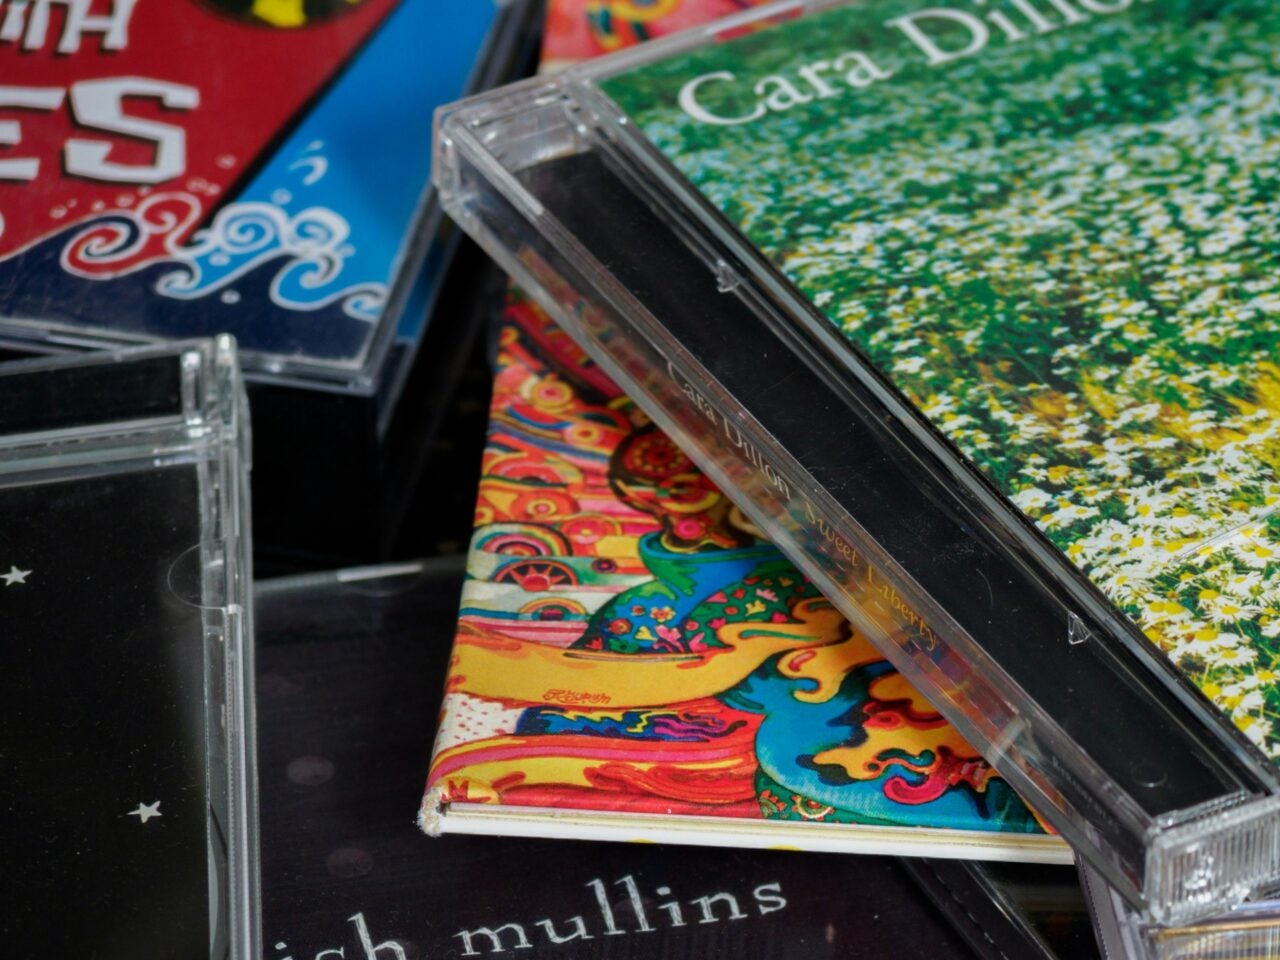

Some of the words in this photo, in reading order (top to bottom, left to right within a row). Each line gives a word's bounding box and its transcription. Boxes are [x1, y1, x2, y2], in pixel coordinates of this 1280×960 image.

[677, 45, 894, 126] Cara
[668, 361, 718, 426] Cara
[722, 415, 791, 502] Dillon
[805, 500, 859, 567] Sweet
[867, 564, 937, 652] Liberty
[452, 874, 788, 957] mullins
